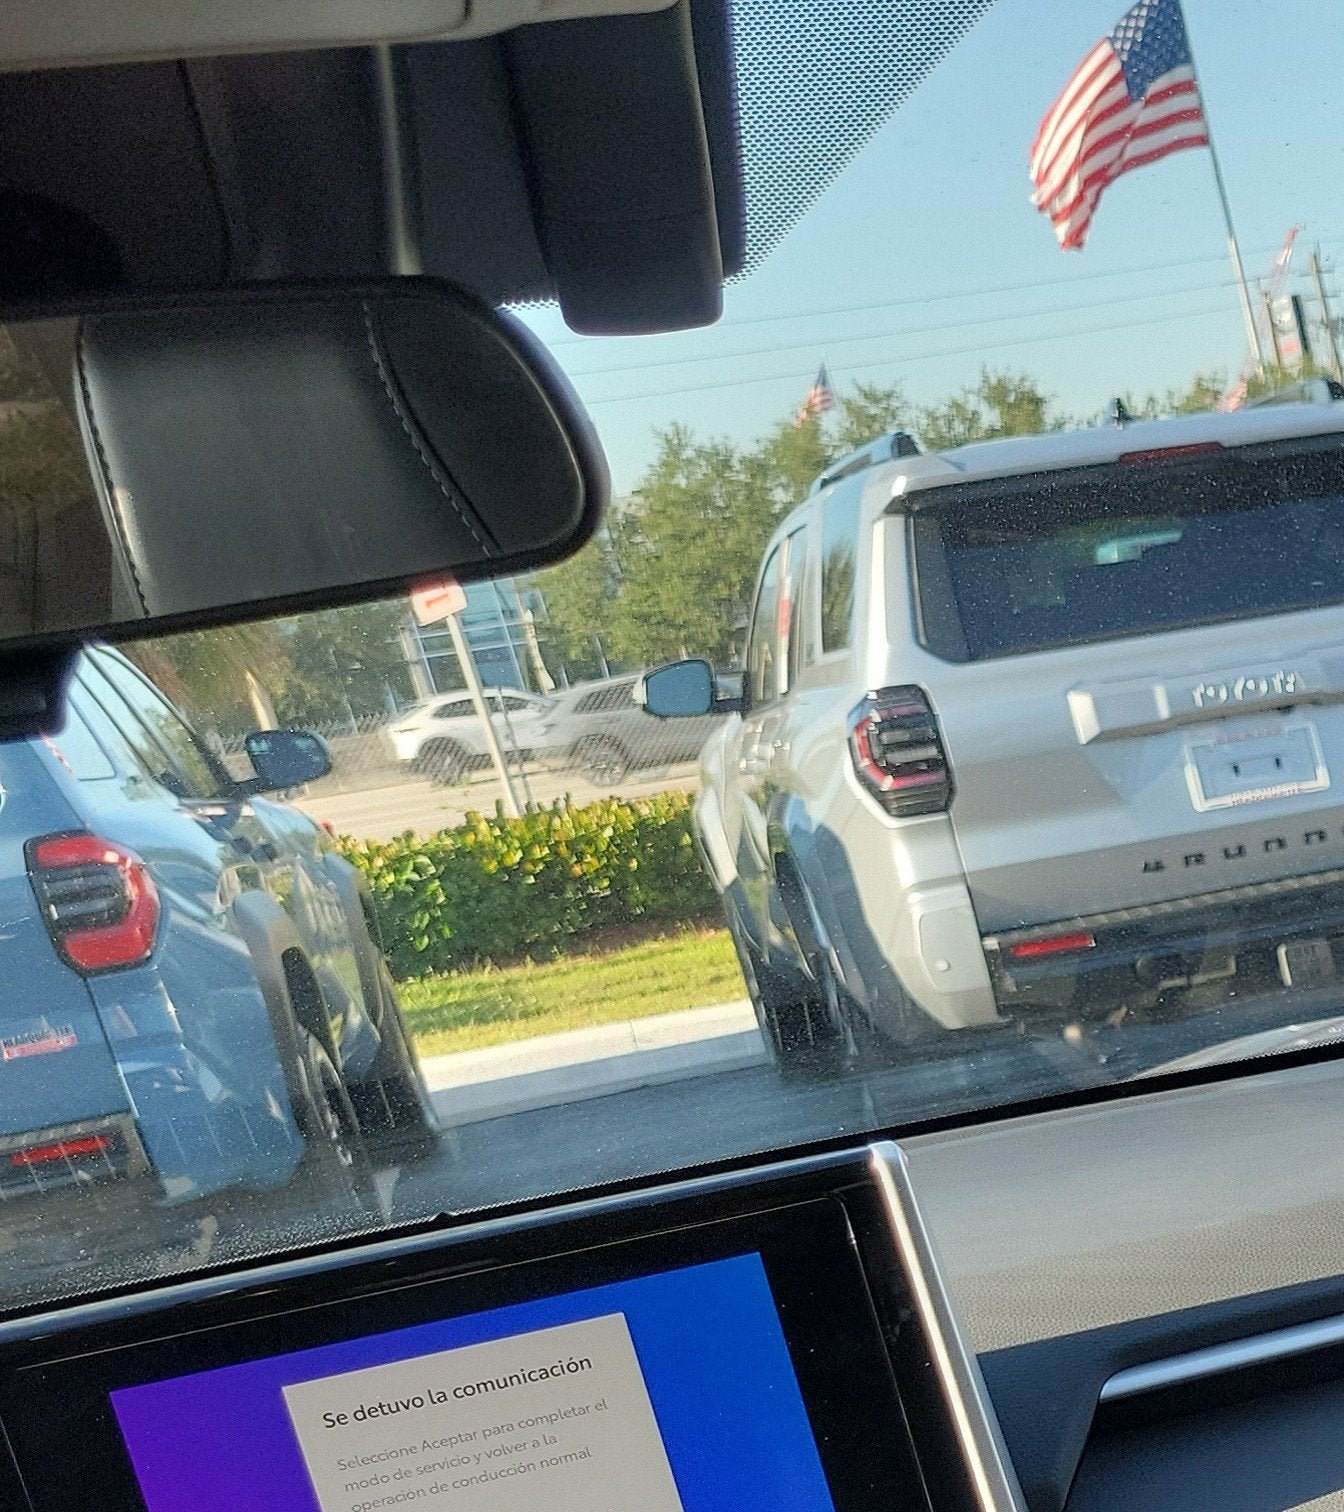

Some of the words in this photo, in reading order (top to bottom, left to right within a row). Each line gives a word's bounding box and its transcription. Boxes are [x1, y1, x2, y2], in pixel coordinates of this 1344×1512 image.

[323, 1412, 349, 1429] Se
[353, 1395, 425, 1423] detuvo
[428, 1389, 448, 1406] la
[452, 1355, 593, 1400] comunicación
[337, 1443, 418, 1471] Seleccione
[421, 1430, 478, 1455] Aceptar
[482, 1422, 515, 1441] para
[518, 1403, 591, 1431] completar
[595, 1398, 609, 1411] el
[345, 1473, 390, 1494] modo
[392, 1466, 412, 1482] de
[416, 1453, 471, 1477] servicio
[473, 1453, 482, 1466] y
[484, 1439, 528, 1460] volver
[532, 1438, 541, 1448] a
[544, 1432, 558, 1446] la
[429, 1480, 449, 1494] de
[452, 1461, 536, 1489] conducción
[540, 1447, 592, 1469] normal
